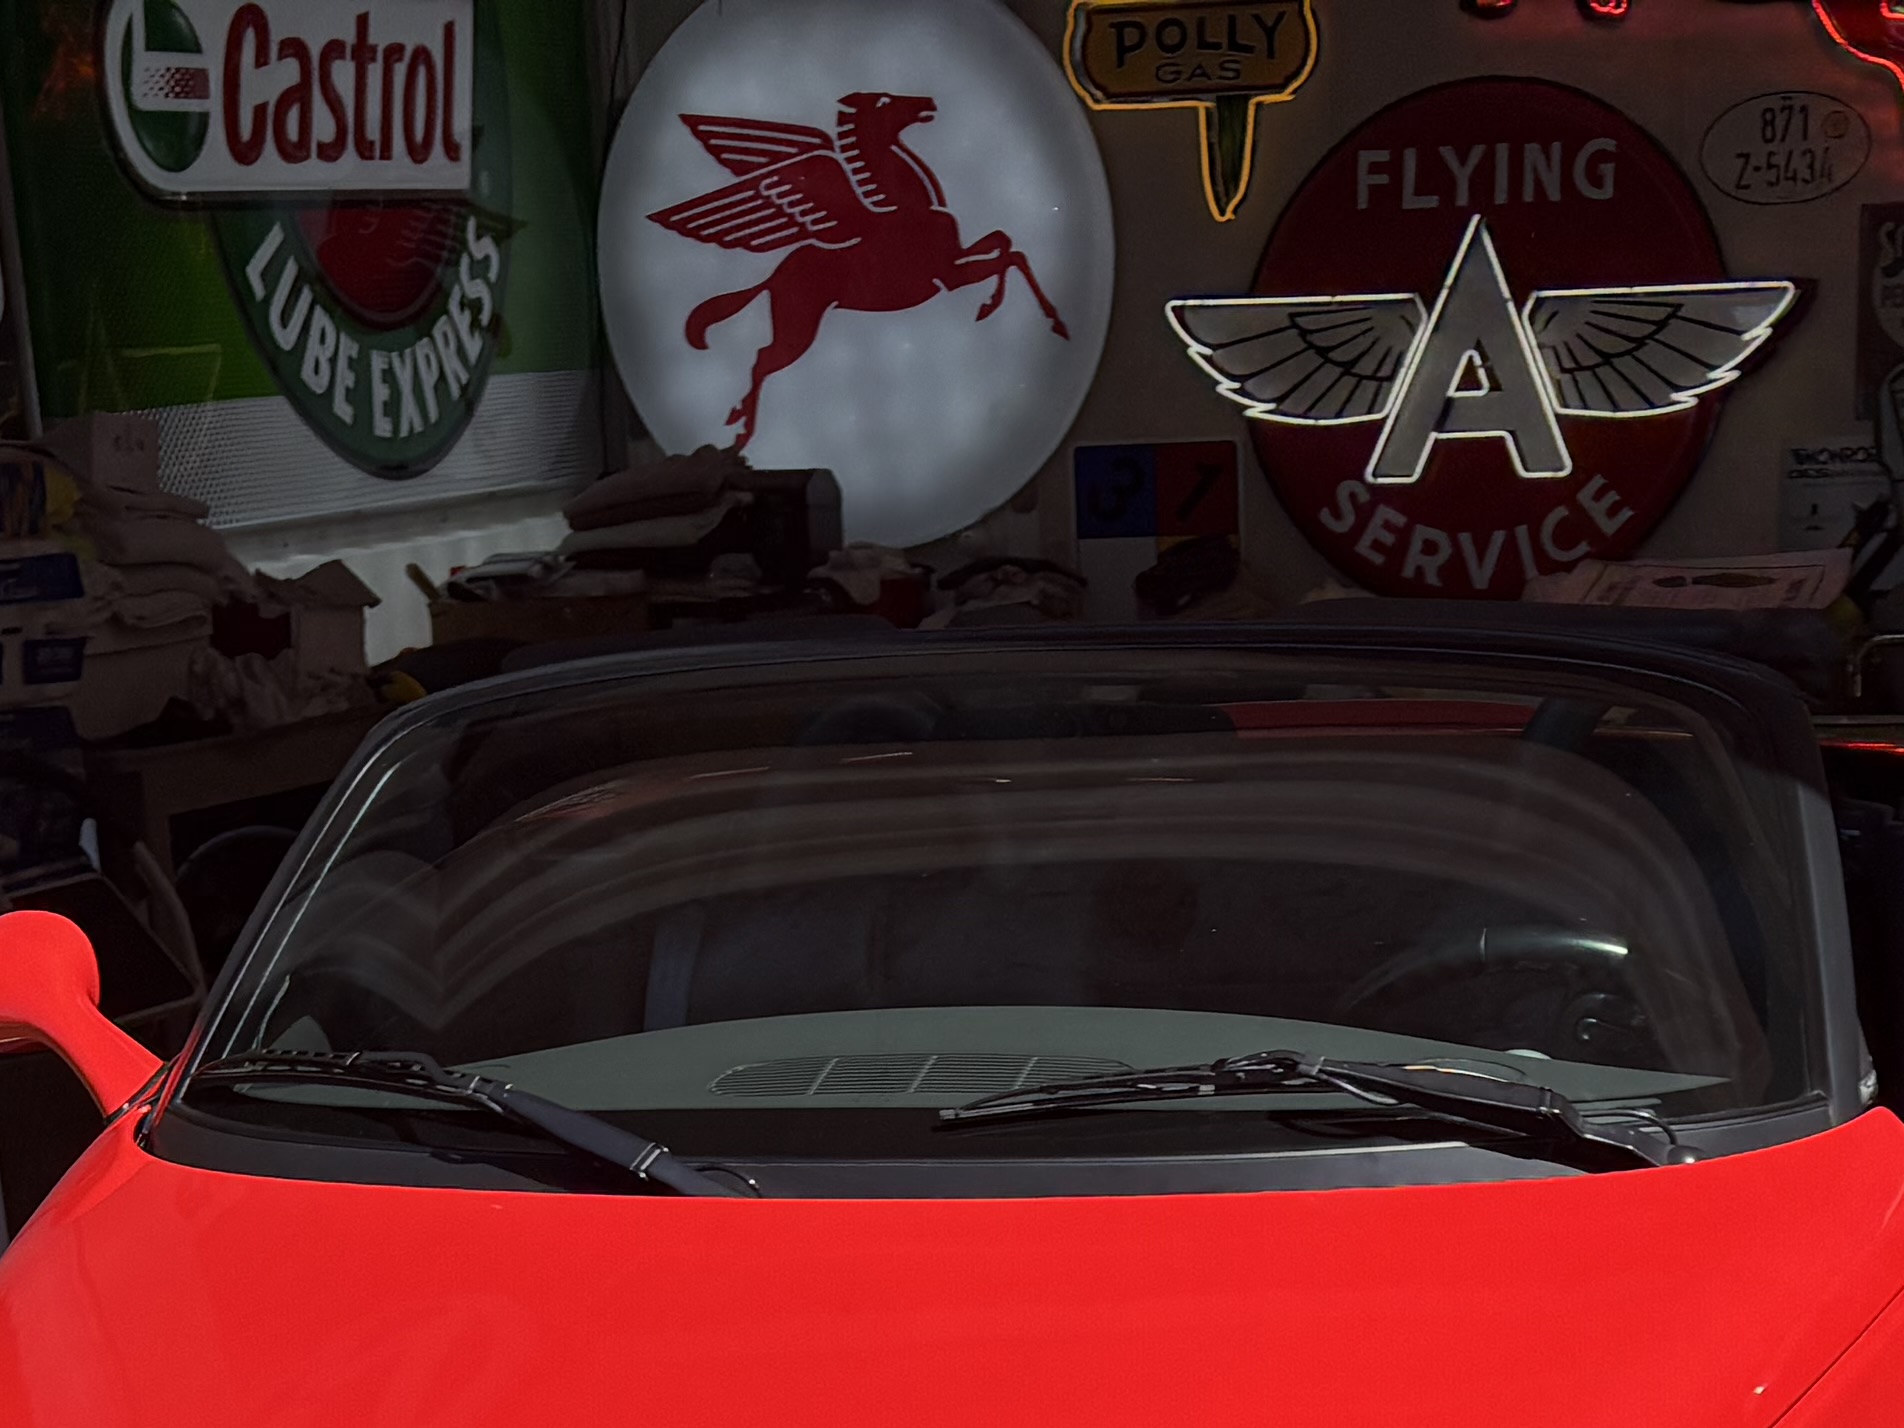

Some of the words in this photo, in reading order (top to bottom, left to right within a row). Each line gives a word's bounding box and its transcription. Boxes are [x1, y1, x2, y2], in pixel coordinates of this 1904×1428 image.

[223, 3, 462, 167] Castrol
[1110, 10, 1289, 69] POLLY
[1155, 58, 1242, 84] GAS
[1762, 103, 1809, 144] 871
[1356, 138, 1618, 210] FLYING
[245, 221, 360, 427] LUBE
[370, 215, 500, 439] EXPRESS
[1364, 214, 1572, 483] A
[1320, 474, 1636, 590] SERVICE
